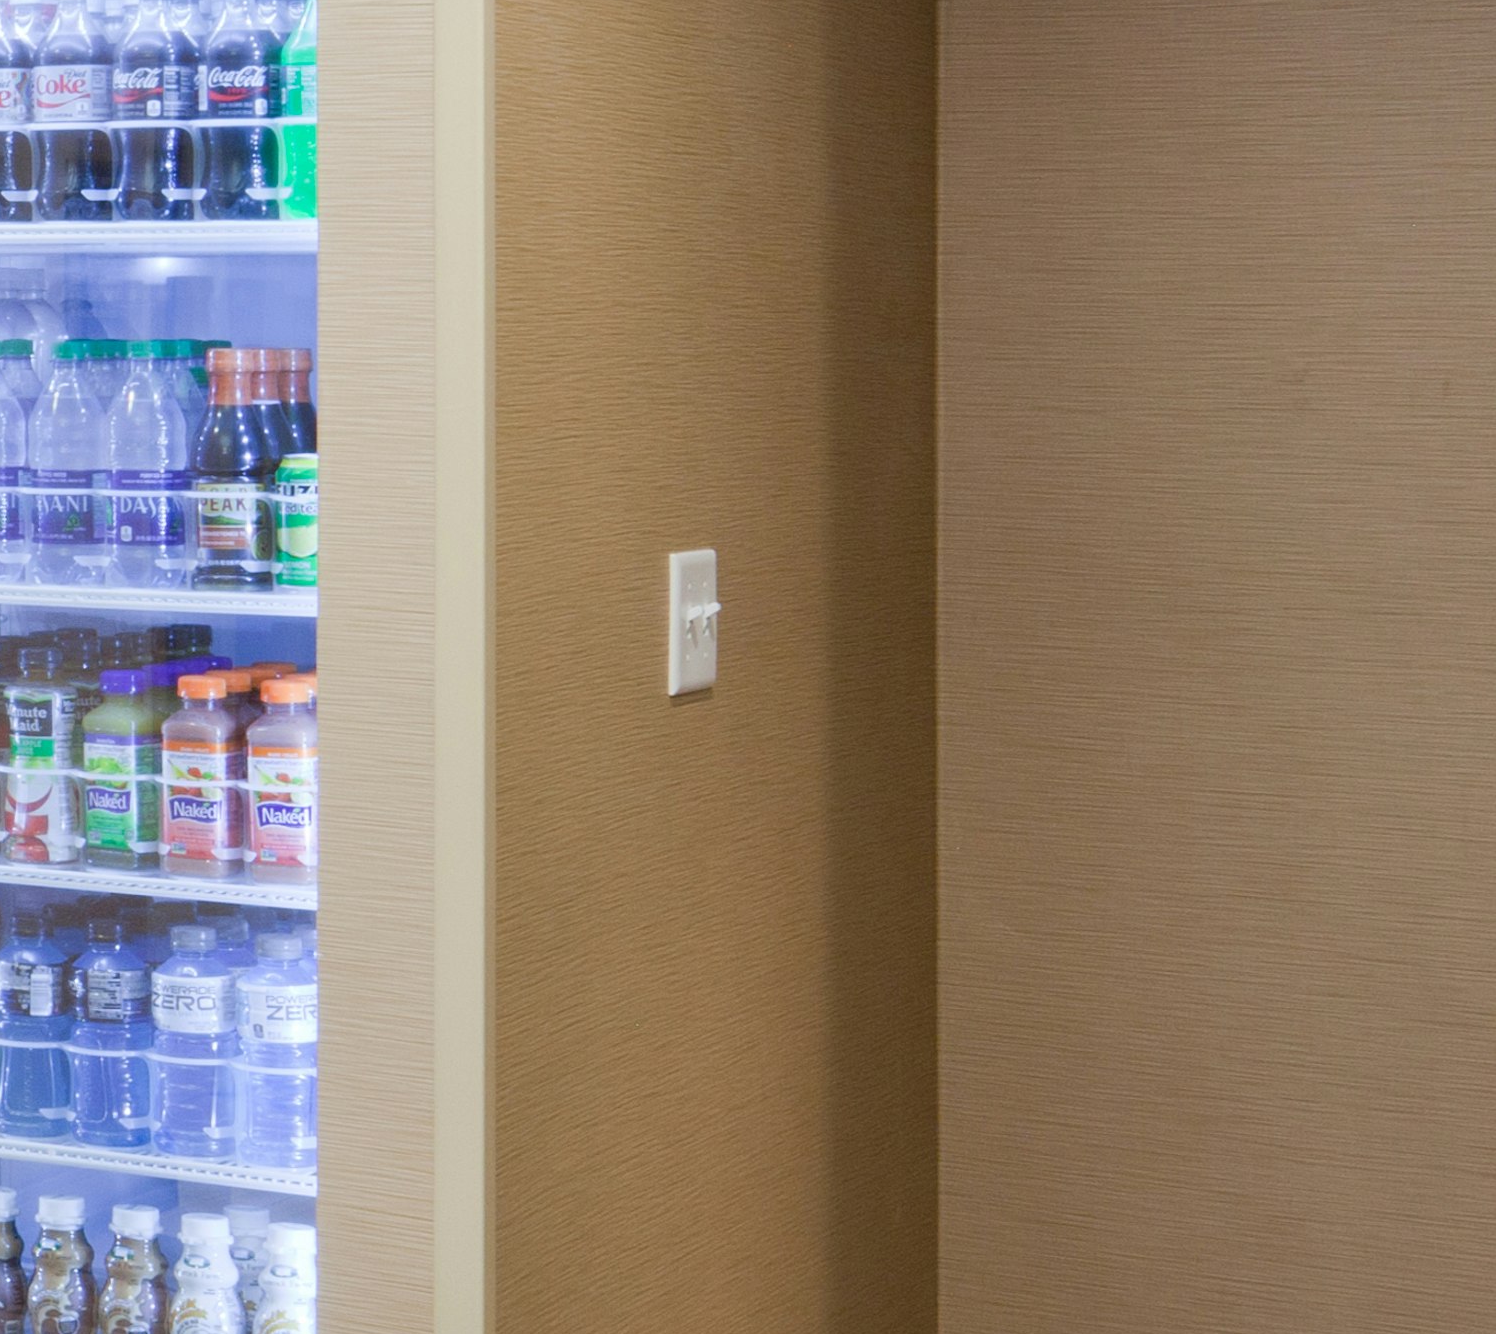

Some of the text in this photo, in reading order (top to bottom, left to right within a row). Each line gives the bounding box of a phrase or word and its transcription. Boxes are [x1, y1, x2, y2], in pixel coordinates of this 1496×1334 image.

[36, 70, 87, 95] Coke
[200, 497, 248, 512] PEAK
[88, 790, 128, 810] Naked
[172, 800, 218, 820] Naked
[262, 807, 312, 826] Naked
[152, 991, 217, 1011] ZERO
[266, 1004, 317, 1021] ZER
